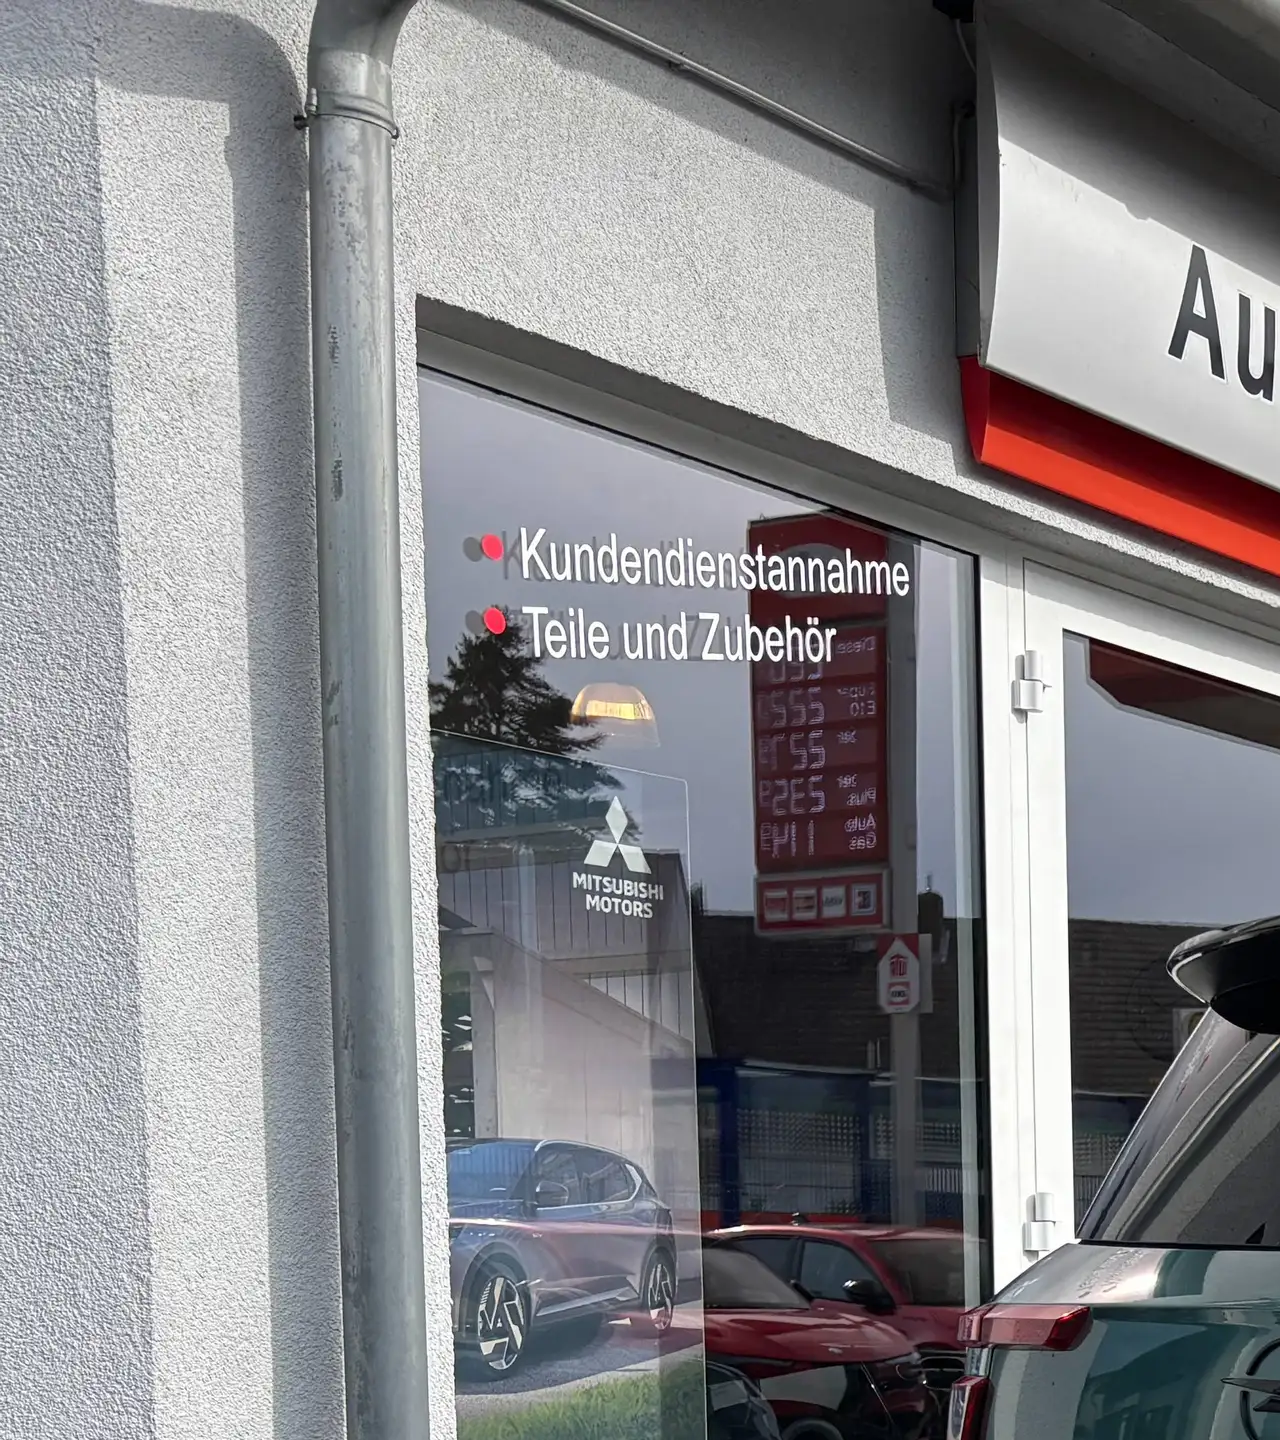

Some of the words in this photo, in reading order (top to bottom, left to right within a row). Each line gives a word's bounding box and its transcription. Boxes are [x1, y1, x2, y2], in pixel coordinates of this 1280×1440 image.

[520, 527, 910, 597] Kundendienstannahme
[521, 606, 611, 660] Teile
[623, 611, 688, 661] und
[700, 611, 837, 663] Zubehör
[573, 871, 664, 901] MITSUBISHI
[585, 894, 654, 919] MOTORS
